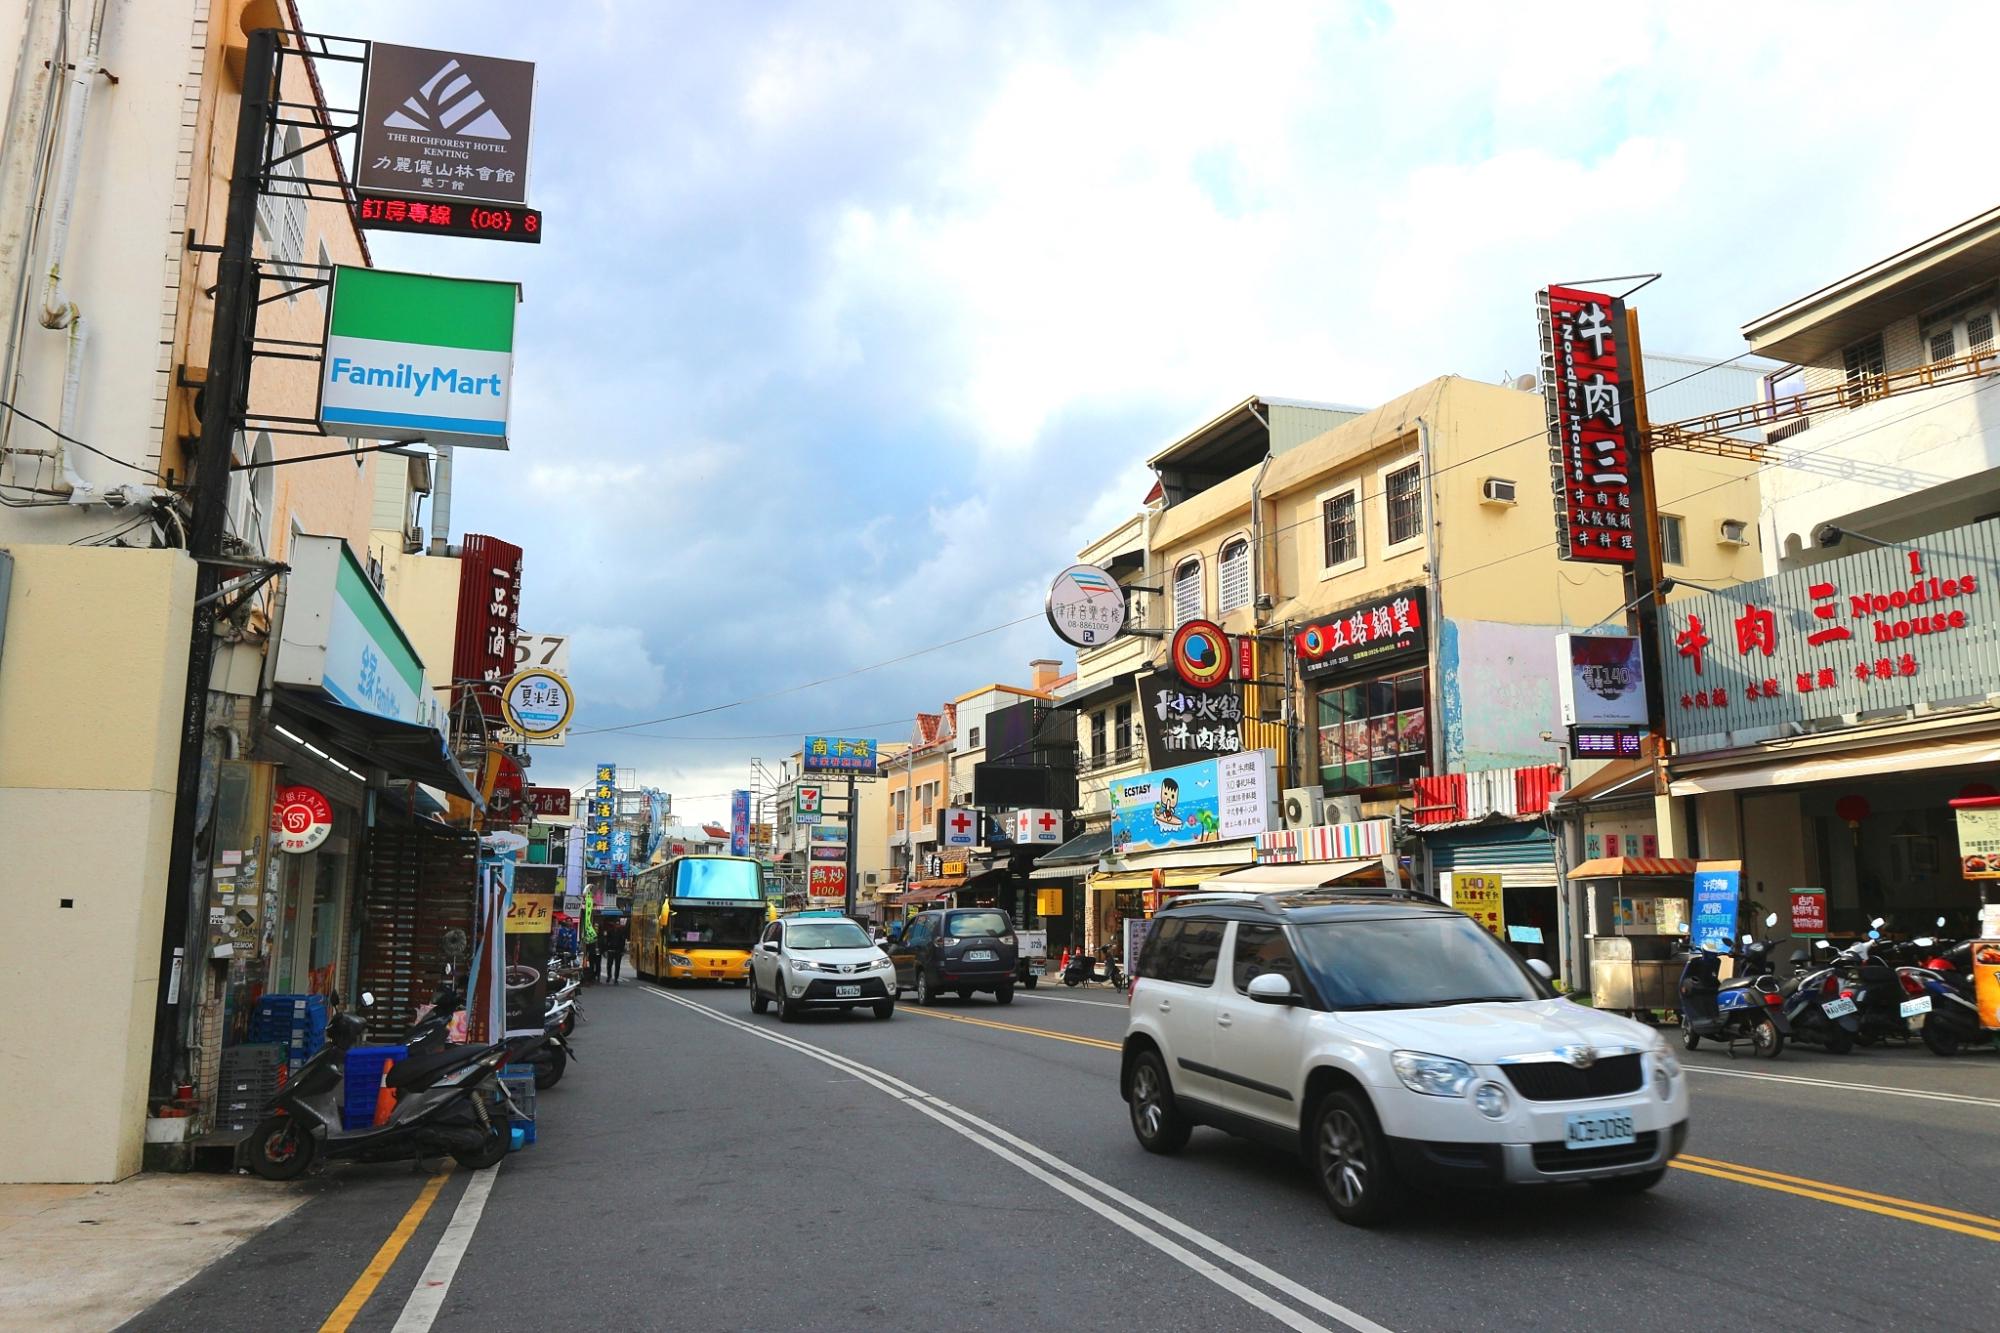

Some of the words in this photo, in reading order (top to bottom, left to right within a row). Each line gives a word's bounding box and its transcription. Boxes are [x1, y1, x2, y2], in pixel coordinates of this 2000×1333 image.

[387, 132, 408, 143] THE
[410, 135, 473, 150] RICHFOREST
[473, 141, 508, 154] HOTEL
[424, 147, 469, 160] KENTING
[372, 155, 516, 183] 力麗儷山林會館
[421, 177, 465, 191] 墾丁館
[361, 198, 452, 225] 訂房專線
[470, 207, 512, 232] (08)
[524, 214, 538, 232] 8
[331, 357, 501, 397] FamilyMart
[1560, 323, 1577, 409] Noodles
[1569, 414, 1583, 481] House
[1575, 489, 1630, 509] 牛肉麵
[1578, 532, 1632, 549] 牛料理
[1850, 573, 1977, 618] Noodles
[1068, 620, 1109, 631] 08-8861009
[1873, 608, 1967, 643] house
[515, 636, 565, 665] 57
[1602, 667, 1629, 685] 140
[520, 684, 560, 707] 夏米屋
[1124, 783, 1151, 798] ECSTASY
[812, 868, 844, 884] 熱炒
[507, 902, 547, 918] 2杯7折
